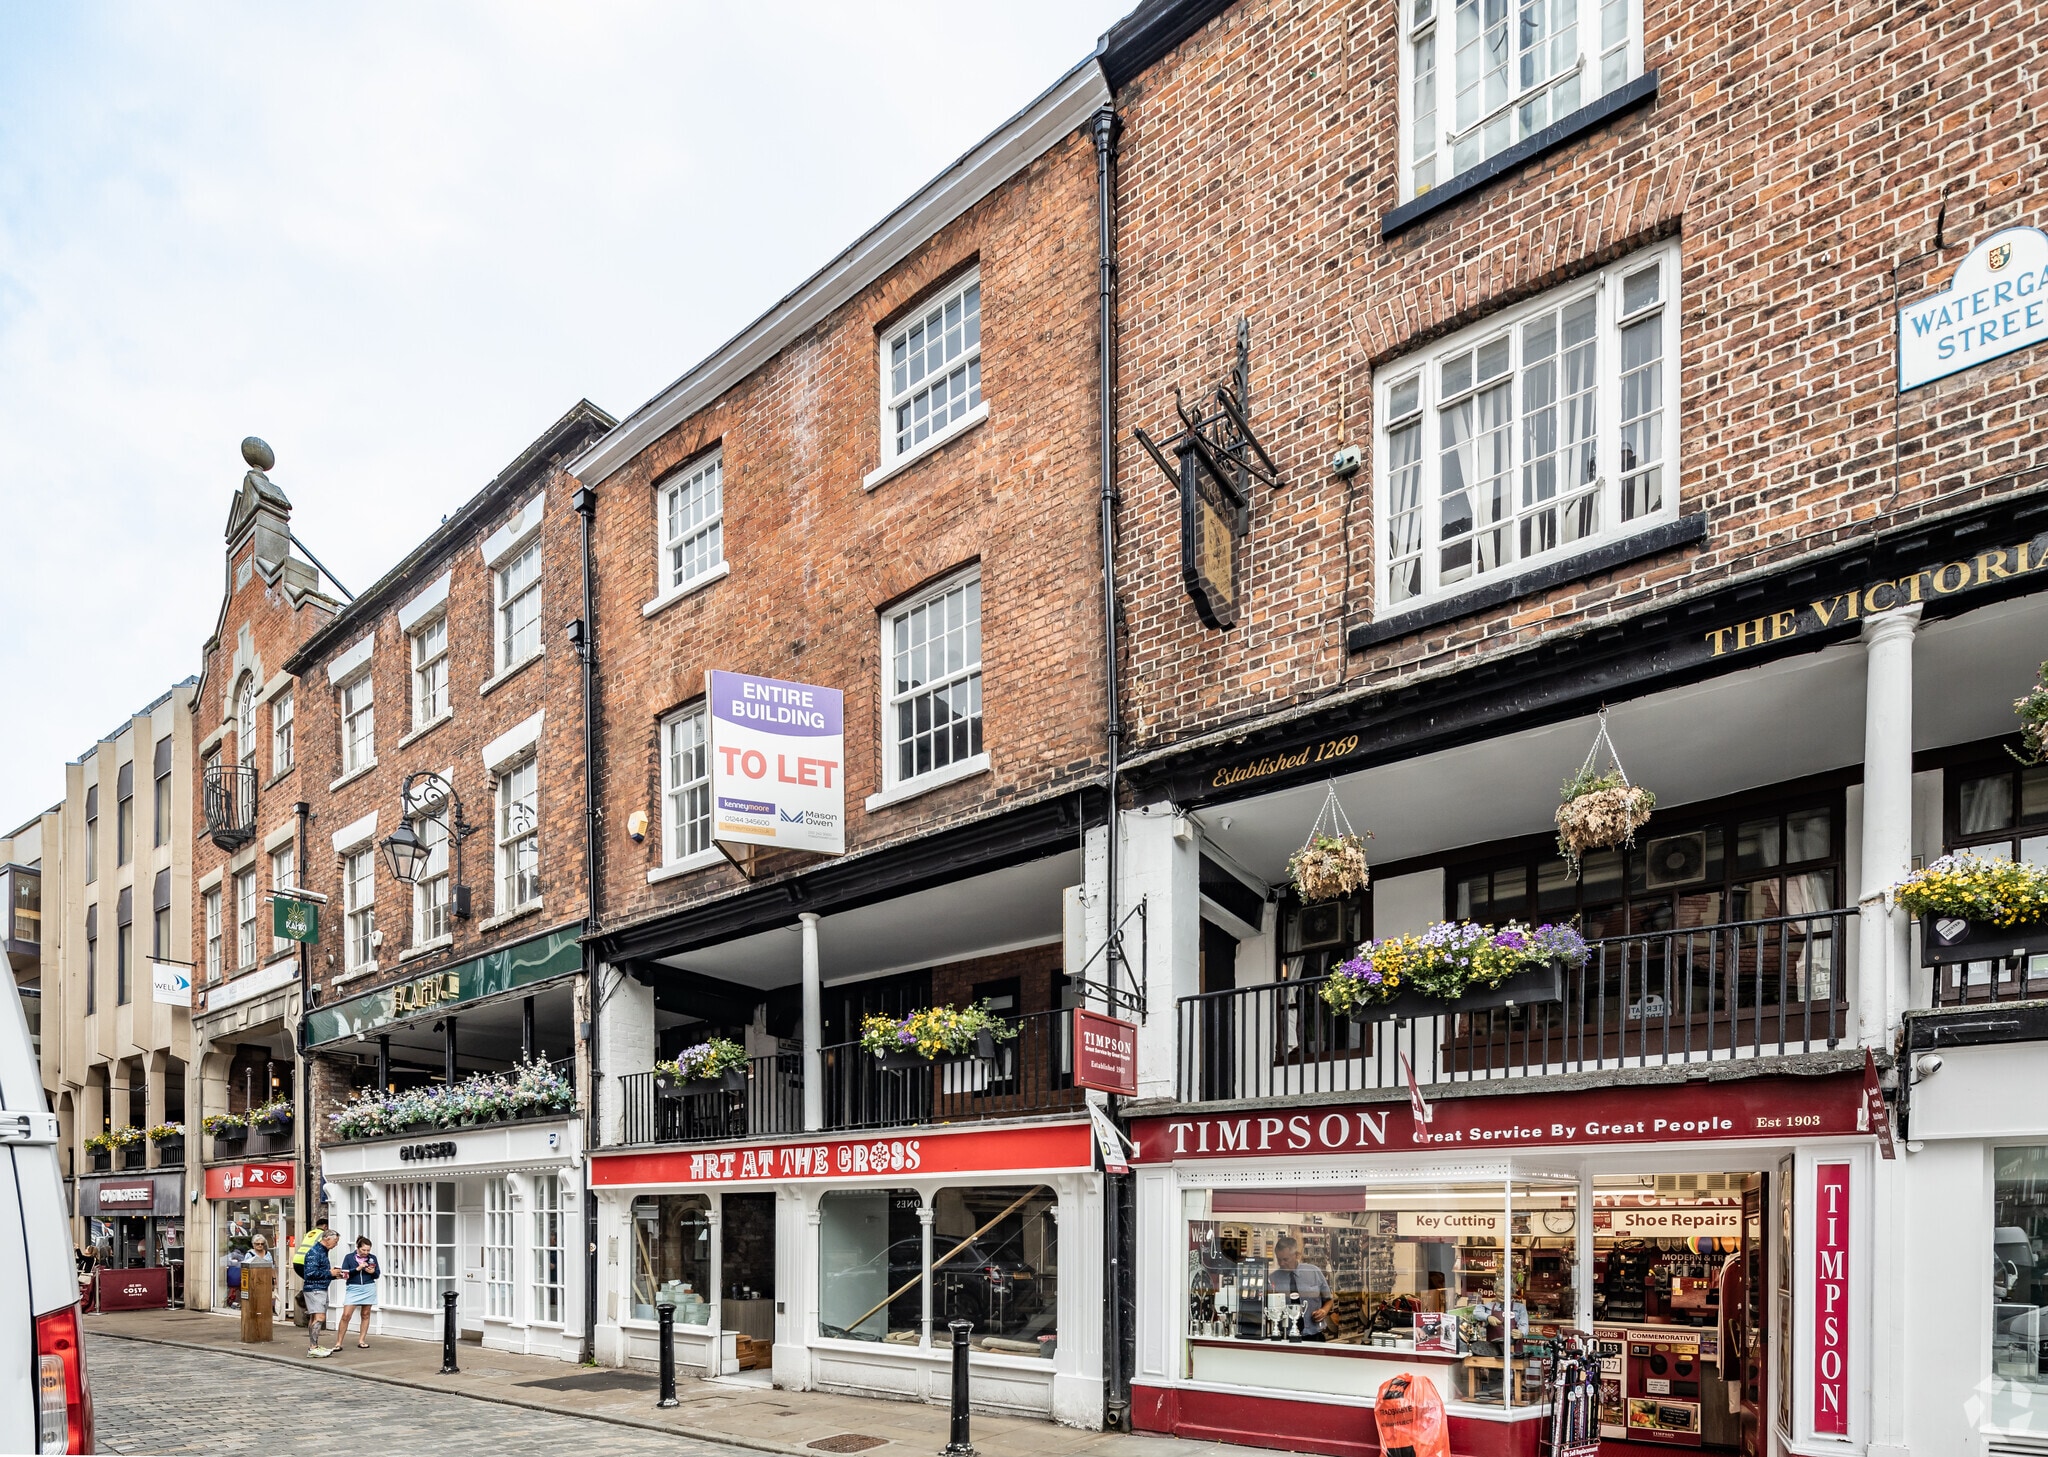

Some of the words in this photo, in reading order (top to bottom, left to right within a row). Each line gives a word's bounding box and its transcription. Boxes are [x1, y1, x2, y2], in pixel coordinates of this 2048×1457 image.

[1938, 298, 2048, 360] STREE
[1705, 608, 1797, 657] THE
[743, 682, 814, 708] ENTIRE
[732, 700, 825, 729] BUILDING
[718, 746, 767, 779] TO
[777, 754, 838, 788] LET
[1212, 746, 1311, 788] Established
[1314, 735, 1359, 762] 1269
[724, 799, 770, 812] kenneymoore
[805, 810, 838, 820] Mason
[805, 818, 833, 827] Owen
[154, 982, 175, 991] WELL
[1083, 1031, 1131, 1055] TIMPSON
[1168, 1111, 1389, 1153] TIMPSON
[1469, 1126, 1542, 1140] Service
[1551, 1123, 1576, 1139] By
[1585, 1121, 1644, 1135] Great
[1653, 1117, 1733, 1135] People
[1756, 1116, 1783, 1128] Est
[1786, 1115, 1821, 1127] 1903
[690, 1152, 735, 1180] ART
[740, 1150, 774, 1177] AT
[780, 1147, 828, 1176] THE
[837, 1140, 921, 1173] CROSS
[1416, 1215, 1440, 1229] Key
[1444, 1215, 1496, 1229] Cutting
[1625, 1213, 1667, 1226] Shoe
[1671, 1213, 1737, 1229] Repairs
[1819, 1184, 1845, 1413] TIMPSON
[1603, 1343, 1618, 1352] 133
[1631, 1333, 1695, 1342] COMMEMORATIVE
[1601, 1360, 1617, 1369] 127
